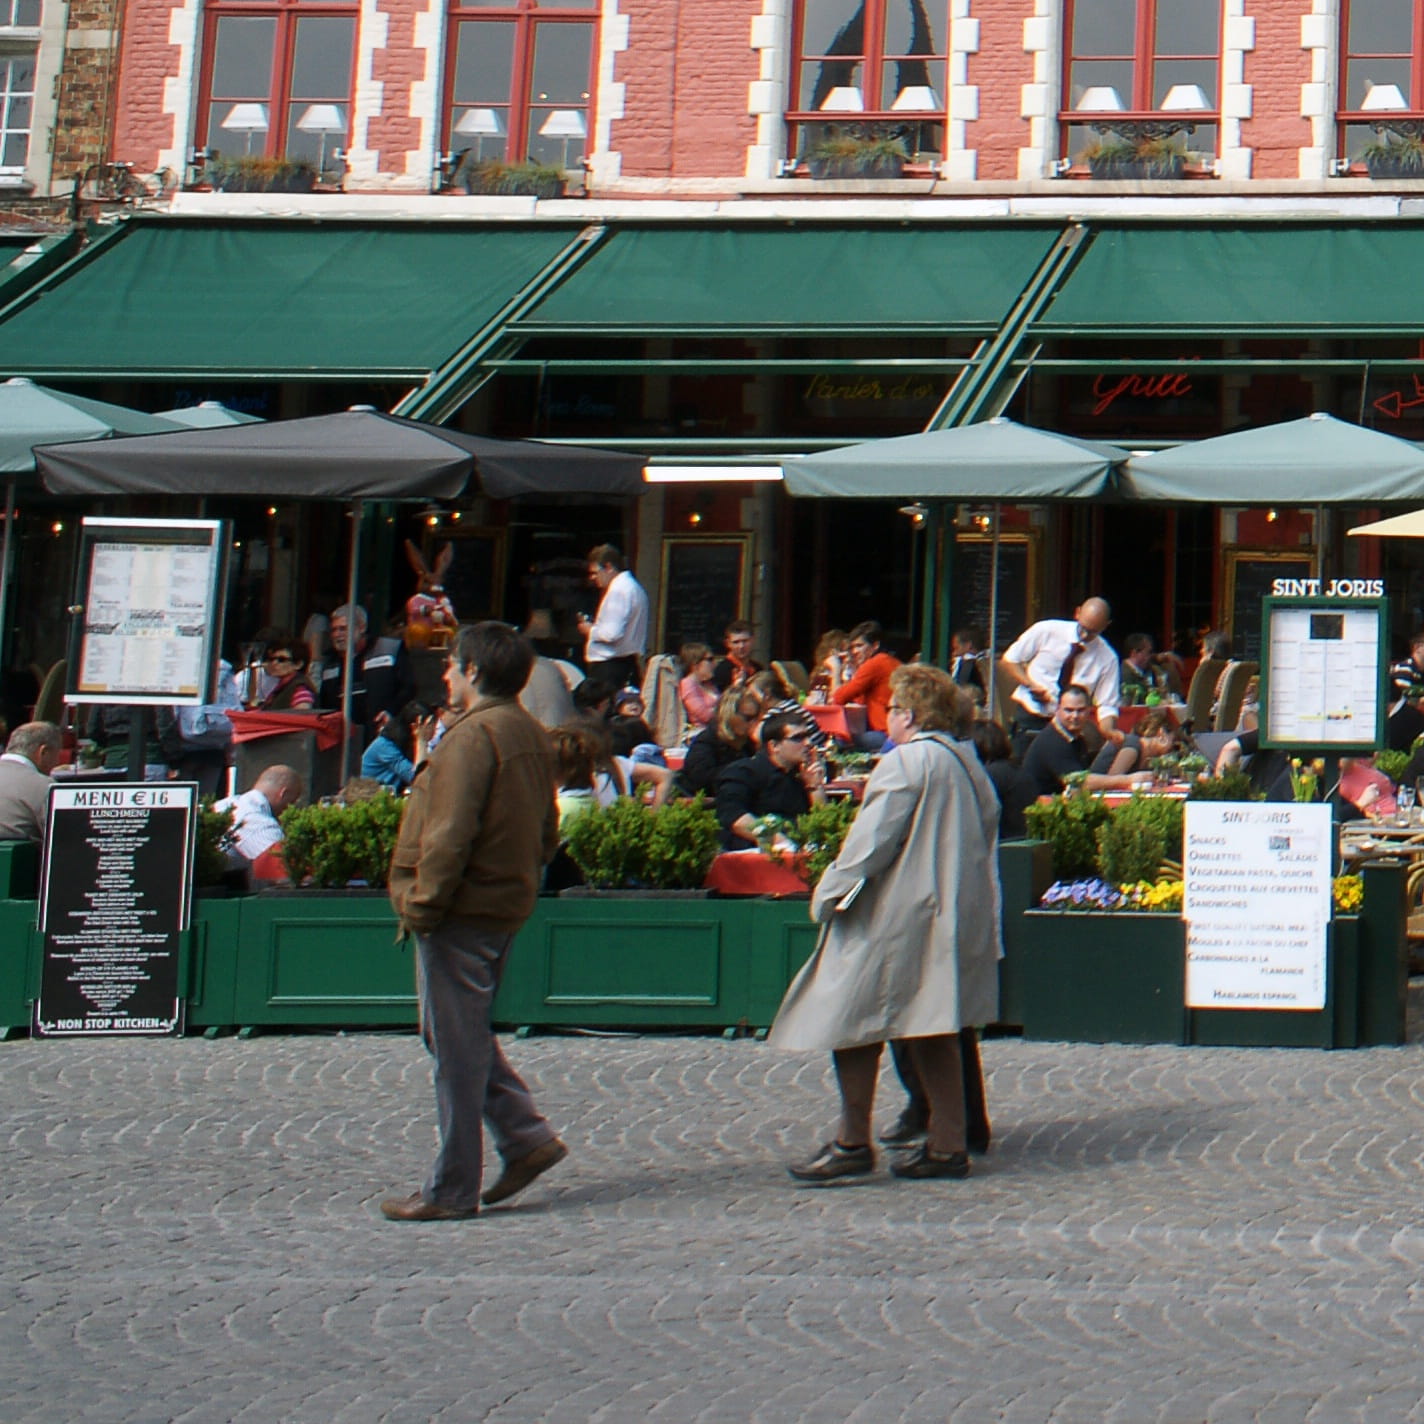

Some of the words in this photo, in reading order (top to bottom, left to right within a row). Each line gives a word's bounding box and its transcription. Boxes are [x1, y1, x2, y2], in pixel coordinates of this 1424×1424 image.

[1272, 578, 1321, 597] SINT
[1325, 579, 1384, 597] JORIS
[73, 791, 124, 806] MENU
[57, 1019, 82, 1030] NON
[84, 1018, 112, 1030] STOP
[113, 1017, 160, 1030] KITCHEN
